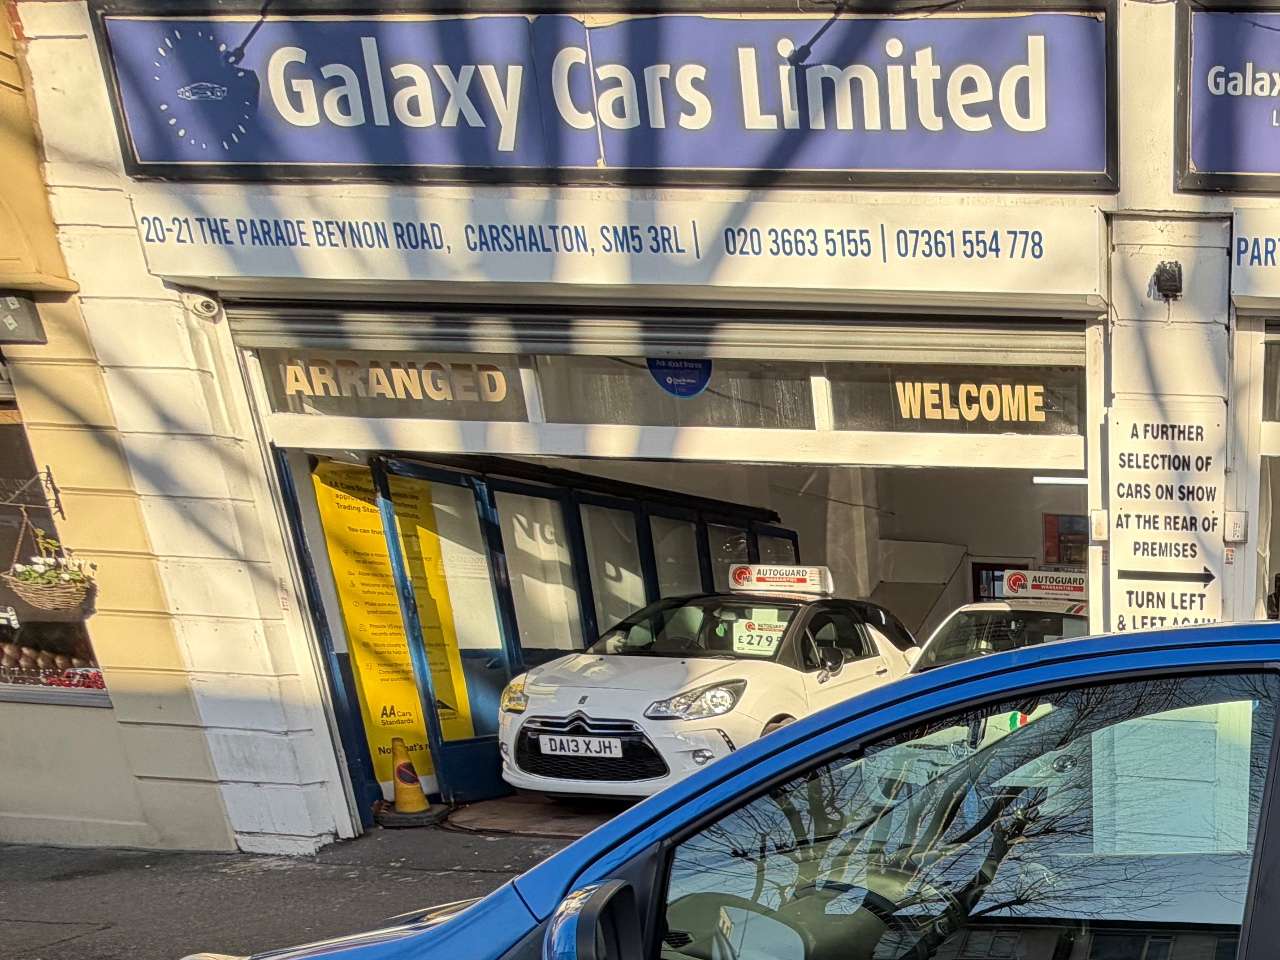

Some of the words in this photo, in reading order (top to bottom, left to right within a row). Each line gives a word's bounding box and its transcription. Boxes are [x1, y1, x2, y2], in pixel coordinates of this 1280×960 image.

[267, 36, 522, 152] Galaxy
[550, 45, 712, 129] Cars
[737, 35, 1047, 132] Limited
[141, 216, 195, 246] 20-21
[196, 217, 233, 246] THE
[236, 218, 310, 248] PARADE
[314, 219, 388, 249] BEYNON
[395, 221, 451, 254] ROAD,
[464, 223, 596, 257] CARSHALTON,
[601, 224, 643, 253] SM5
[648, 225, 685, 254] 3RL
[724, 226, 762, 256] 020
[768, 227, 819, 257] 3663
[825, 228, 872, 258] 5155
[896, 229, 955, 259] 07361
[961, 229, 1001, 259] 554
[1007, 230, 1044, 259] 778
[285, 360, 508, 403] ARRANGED
[895, 380, 1047, 423] WELCOME
[1131, 423, 1139, 440] A
[1144, 423, 1204, 442] FURTHER
[1119, 452, 1191, 471] SELECTION
[1195, 456, 1213, 472] OF
[1117, 482, 1151, 499] CARS
[1155, 484, 1174, 500] ON
[1178, 485, 1217, 501] SHOW
[335, 502, 362, 513] Trading
[1116, 514, 1131, 530] AT
[1135, 514, 1159, 531] THE
[1164, 516, 1198, 532] REAR
[1201, 516, 1219, 533] OF
[1133, 541, 1198, 559] PREMISES
[757, 568, 808, 577] AUTOGUARD
[1032, 575, 1085, 586] AUTOGUARD
[1126, 590, 1166, 609] TURN
[1171, 592, 1206, 611] LEFT
[1117, 615, 1127, 631] &
[1132, 615, 1167, 630] LEFT
[381, 705, 396, 718] AA
[381, 718, 414, 726] Standards
[548, 738, 580, 753] DA13
[583, 739, 613, 754] XJH
